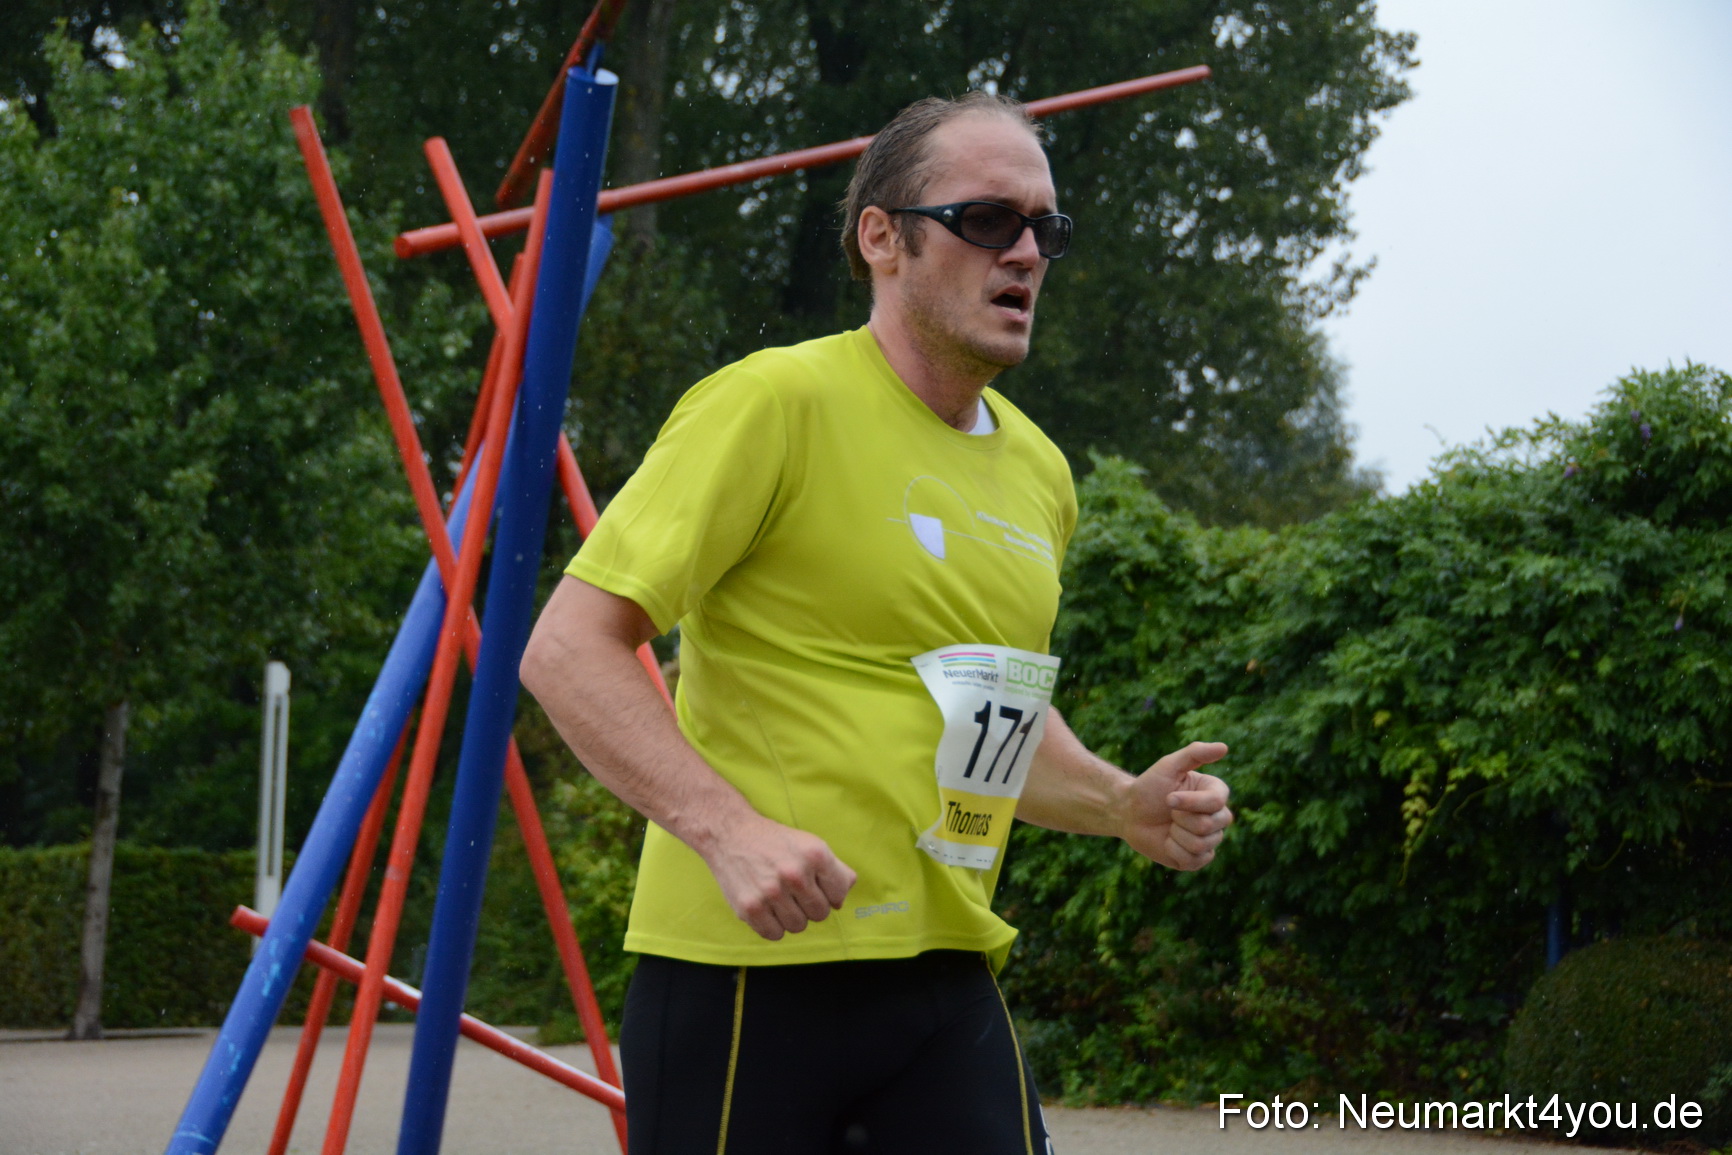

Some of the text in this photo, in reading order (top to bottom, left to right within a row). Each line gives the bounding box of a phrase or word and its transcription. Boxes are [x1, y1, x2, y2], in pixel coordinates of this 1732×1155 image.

[1007, 657, 1057, 691] BOC
[963, 700, 1038, 784] 171
[946, 801, 992, 837] Thomas
[855, 901, 909, 919] SPIRO
